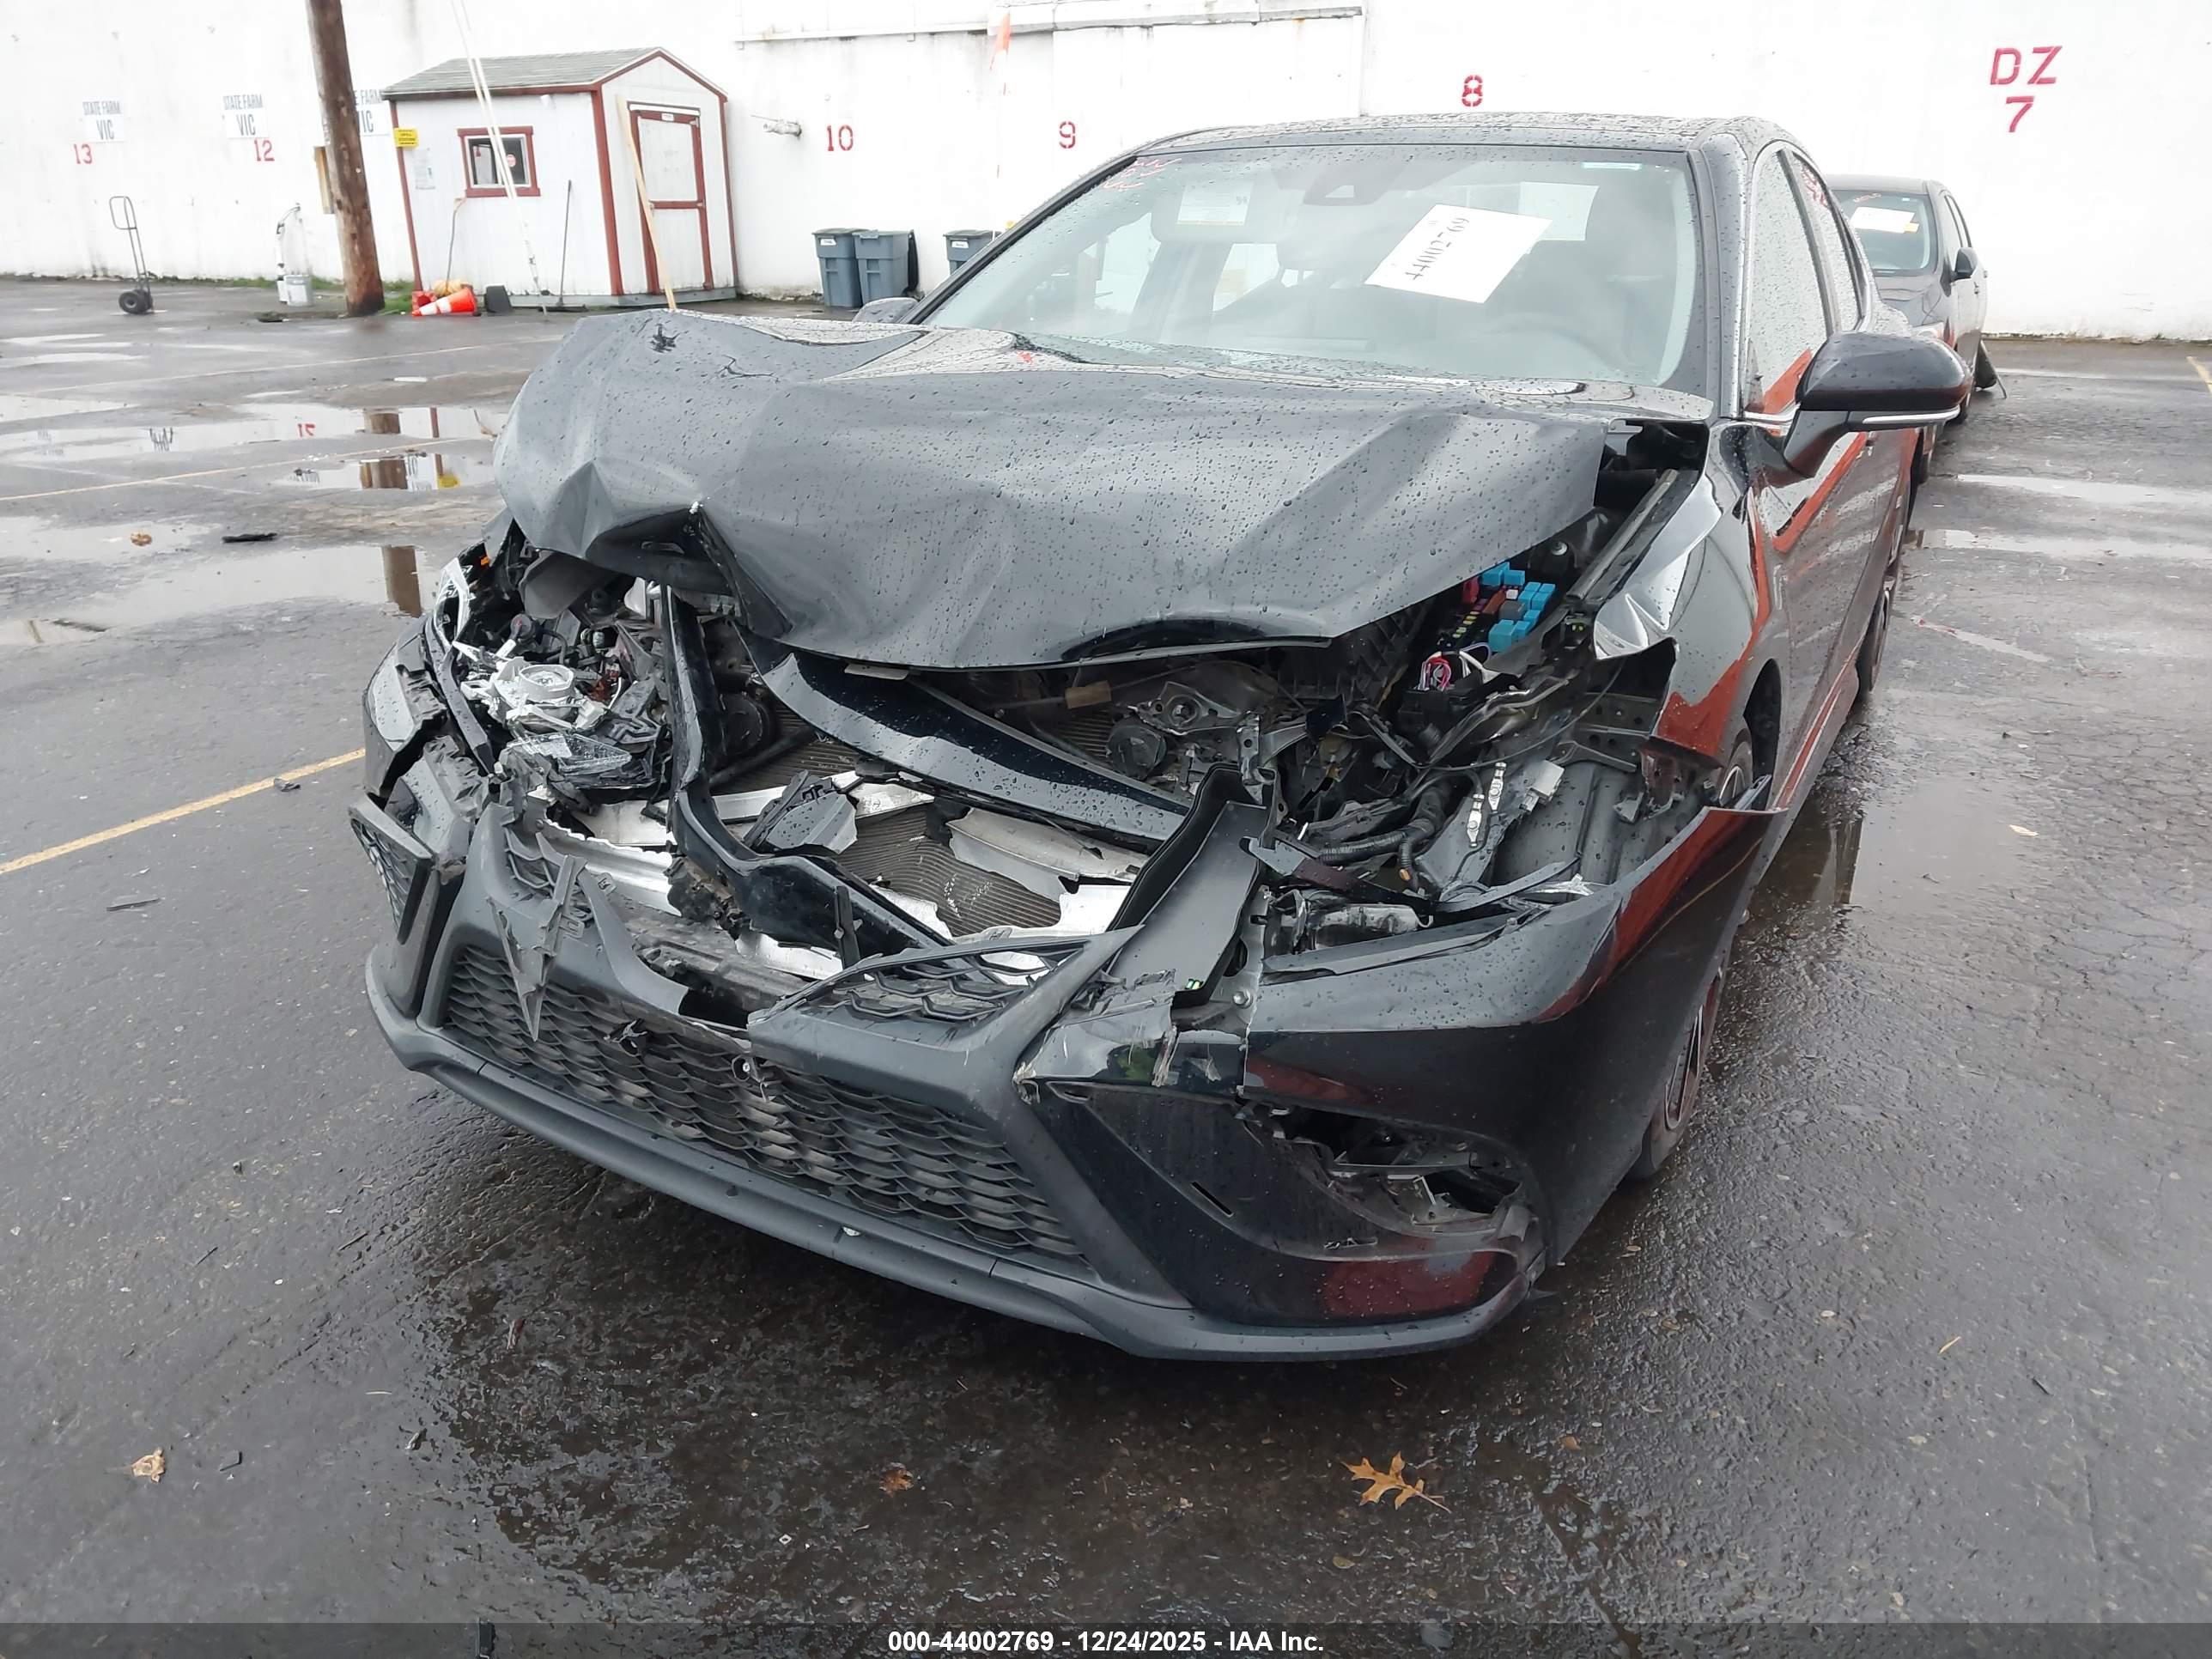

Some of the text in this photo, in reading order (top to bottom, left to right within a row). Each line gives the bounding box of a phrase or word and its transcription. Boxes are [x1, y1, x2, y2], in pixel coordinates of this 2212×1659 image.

[1990, 46, 2063, 85] DZ
[1461, 75, 1483, 108] 8
[236, 113, 256, 136] VIC
[360, 110, 374, 133] IC
[2005, 95, 2034, 133] 7
[96, 119, 114, 140] VIC
[826, 125, 854, 151] 10
[1059, 121, 1077, 149] 9
[74, 143, 93, 165] 13
[254, 139, 275, 161] 12
